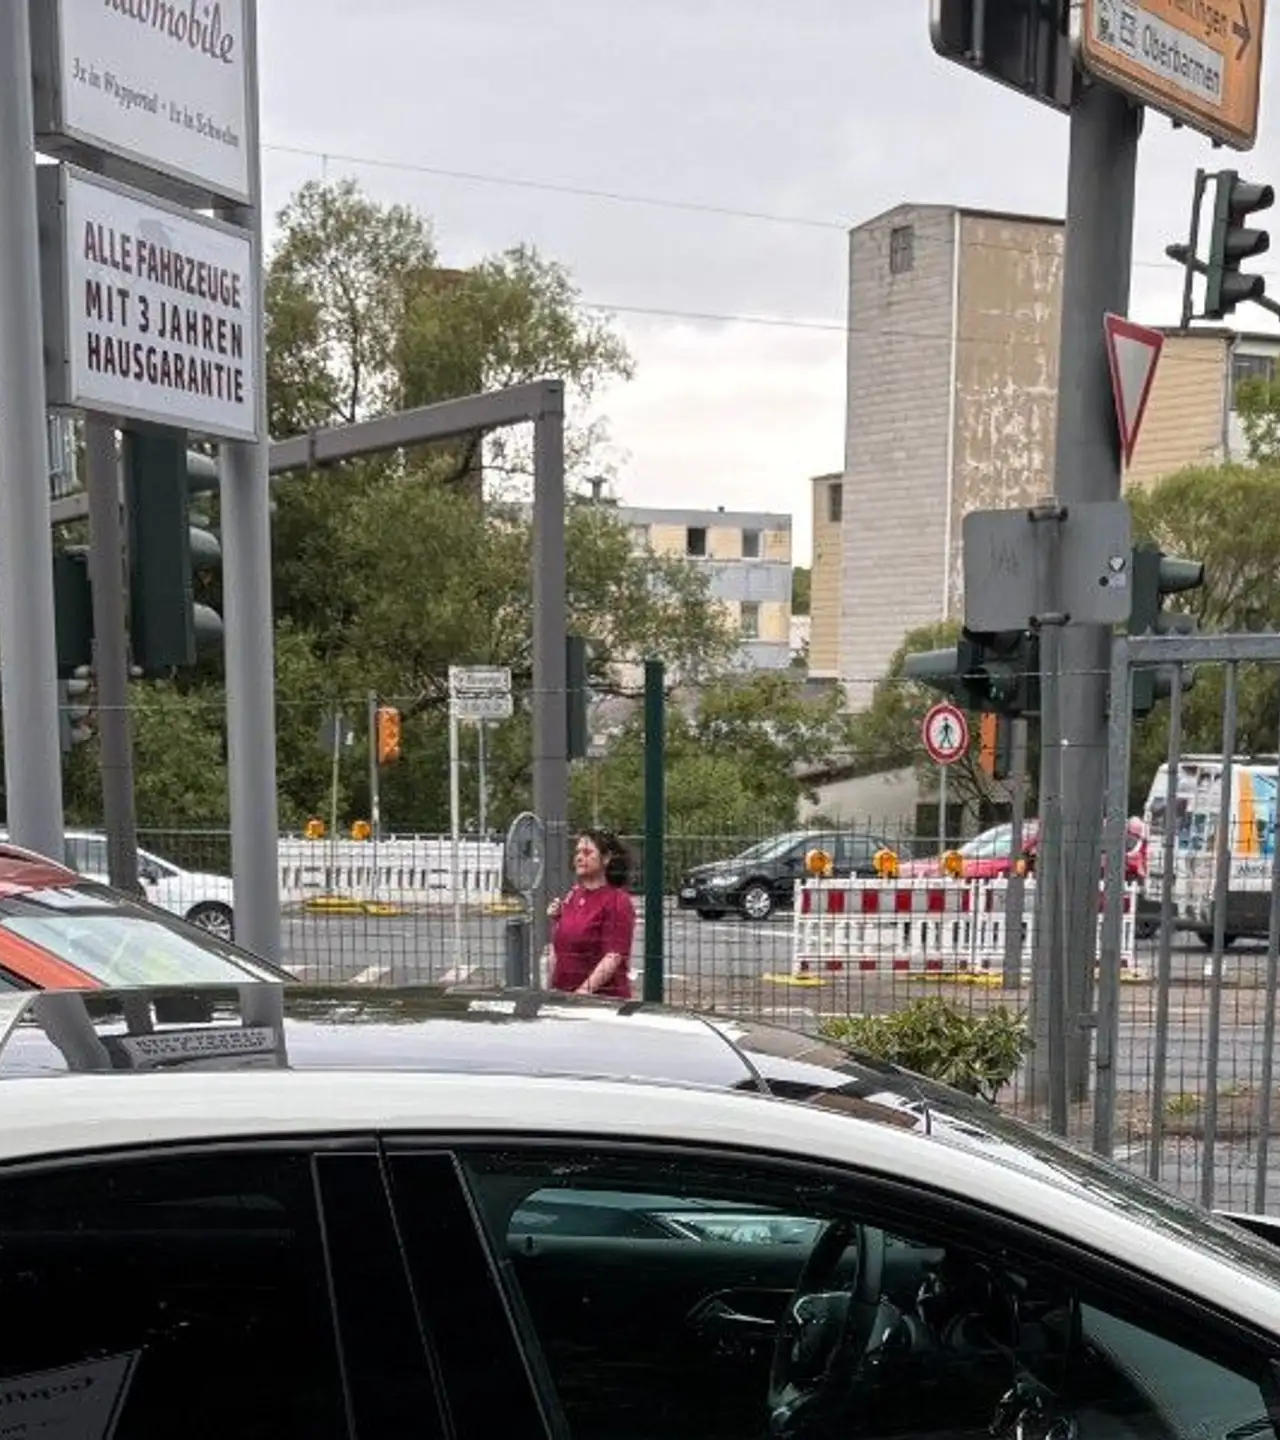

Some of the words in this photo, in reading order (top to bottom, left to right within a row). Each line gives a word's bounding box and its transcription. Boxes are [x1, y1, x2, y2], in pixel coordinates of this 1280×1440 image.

[89, 63, 101, 89] in
[1141, 24, 1220, 96] Oberbarmen
[84, 220, 133, 275] ALLE
[135, 238, 242, 309] FAHRZEUGE
[85, 278, 130, 327] MIT
[137, 294, 150, 333] 3
[158, 301, 244, 359] JAHREN
[86, 331, 245, 403] HAUSGARANTIE
